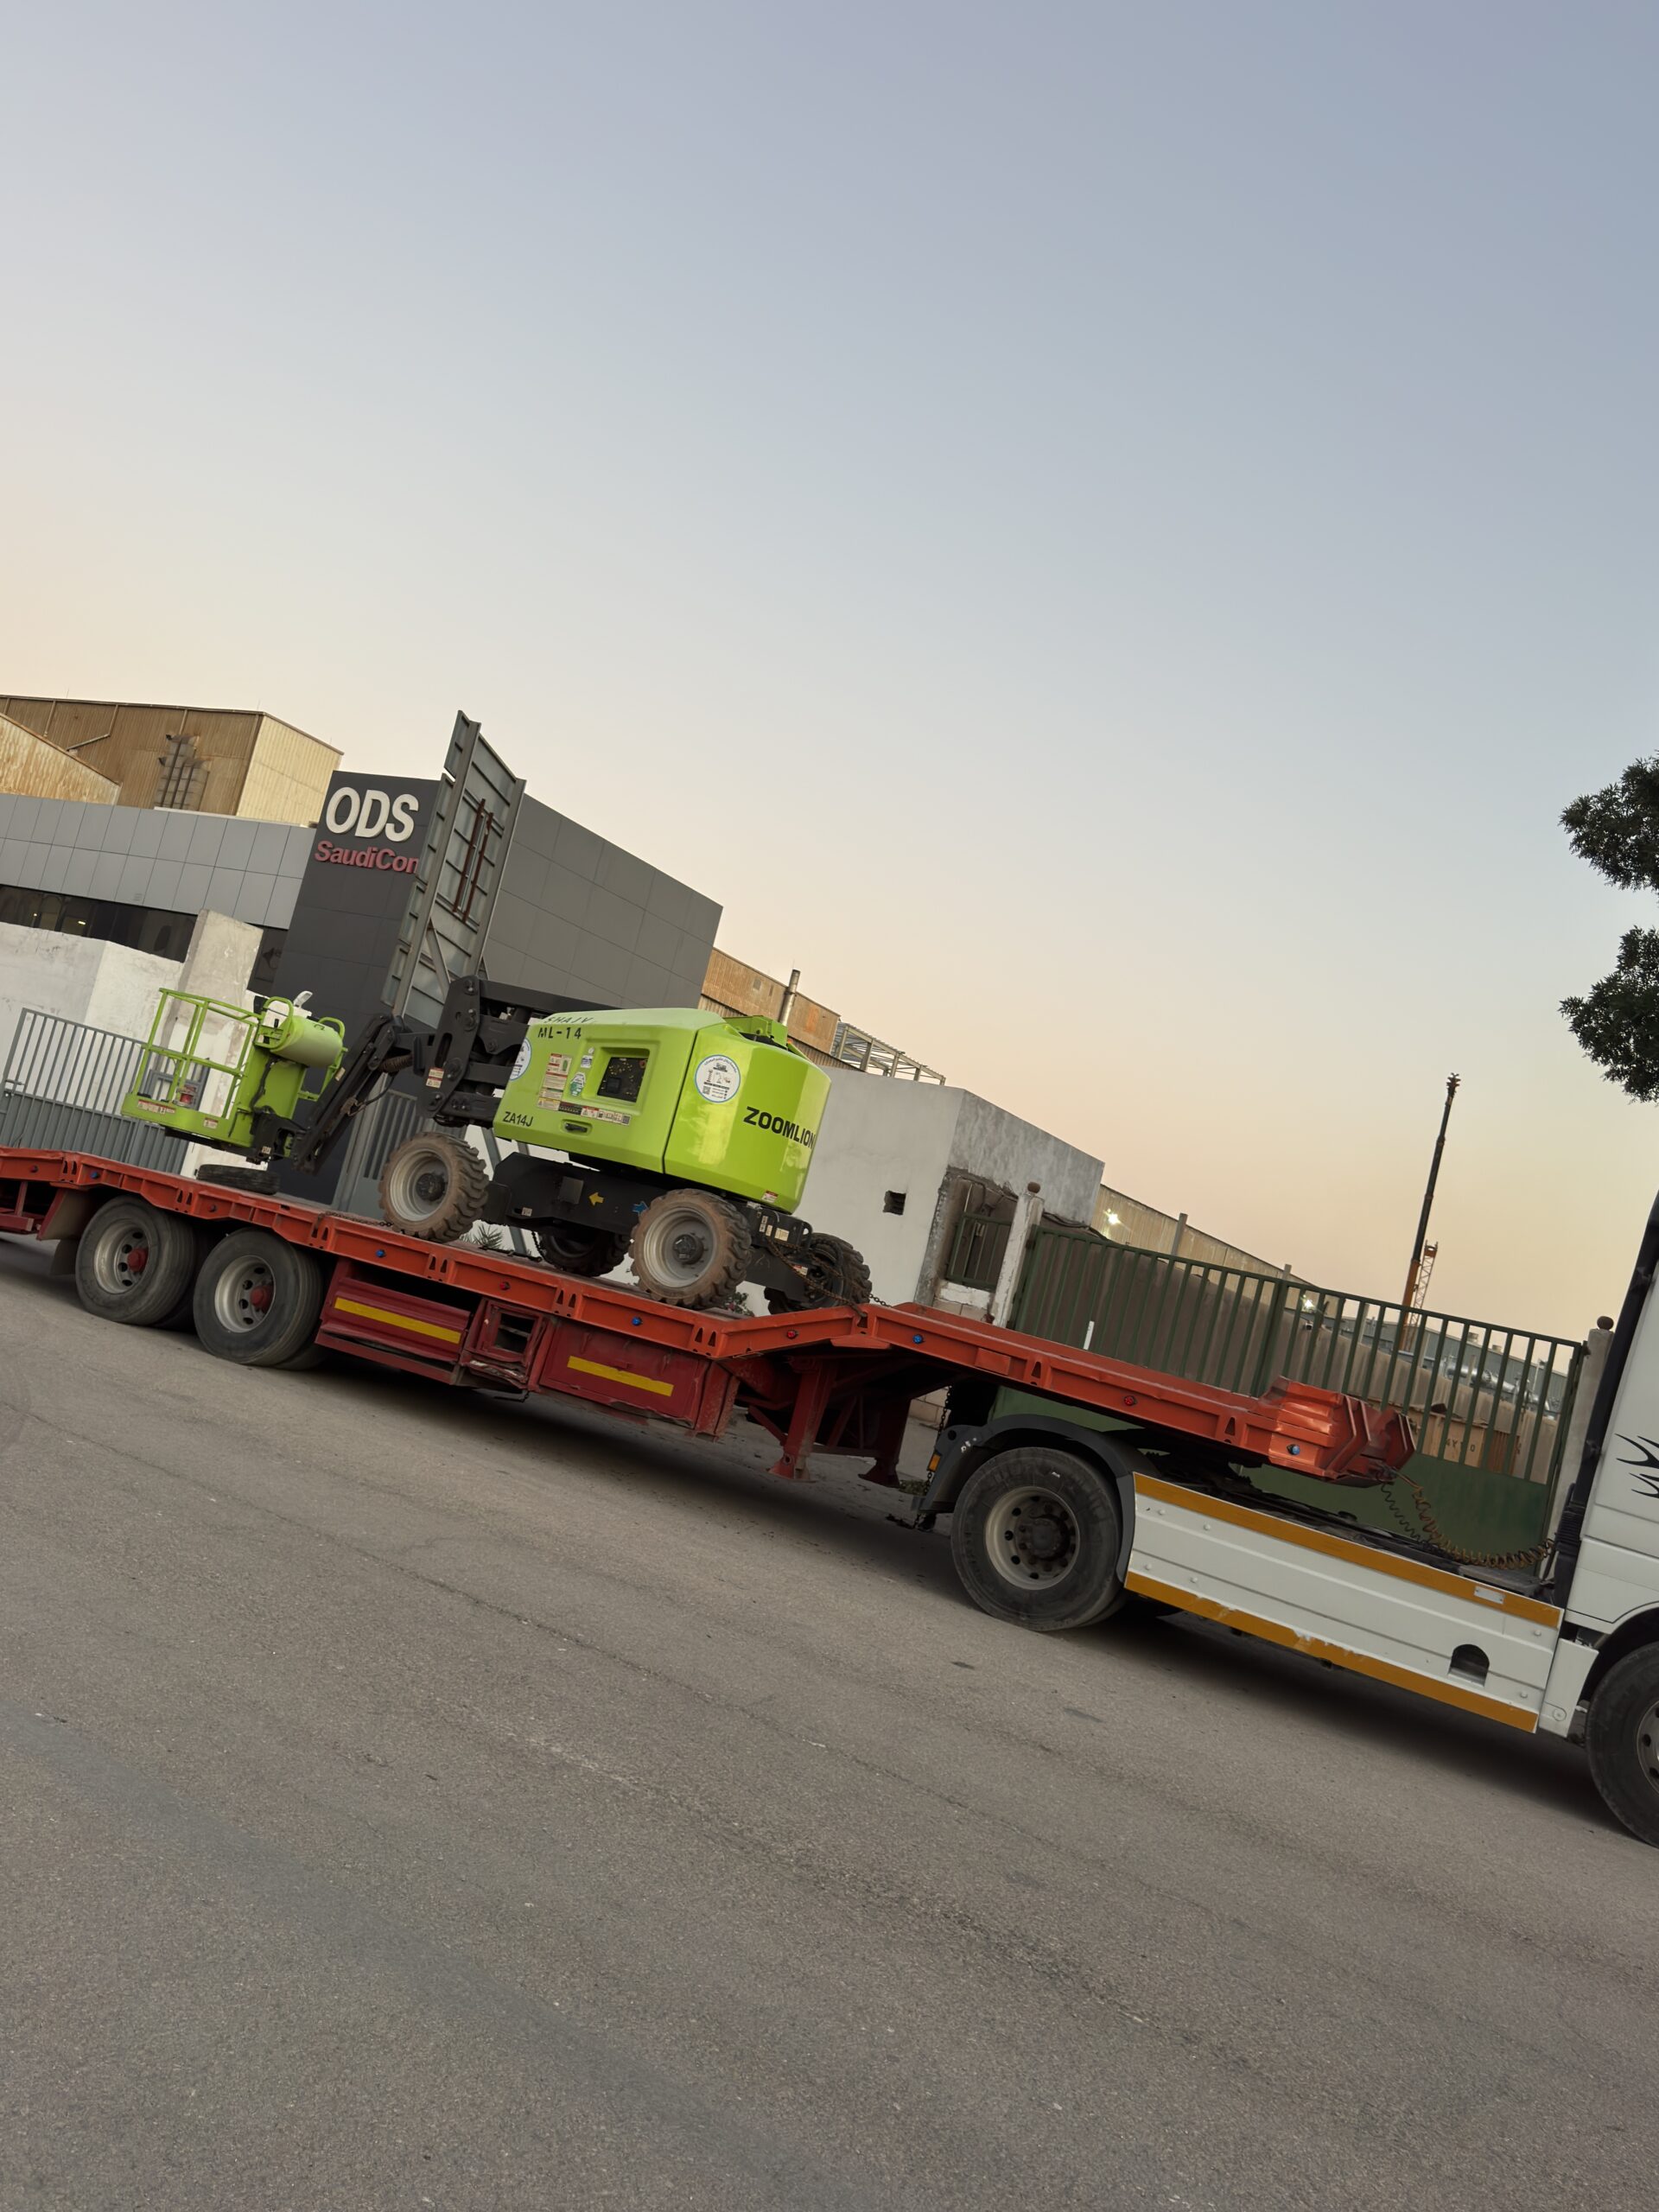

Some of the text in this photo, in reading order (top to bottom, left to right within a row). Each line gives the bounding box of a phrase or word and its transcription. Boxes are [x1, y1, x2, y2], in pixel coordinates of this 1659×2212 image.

[326, 787, 419, 842] ODS
[503, 1111, 534, 1128] ZA14J
[743, 1106, 817, 1149] ZOOMLION
